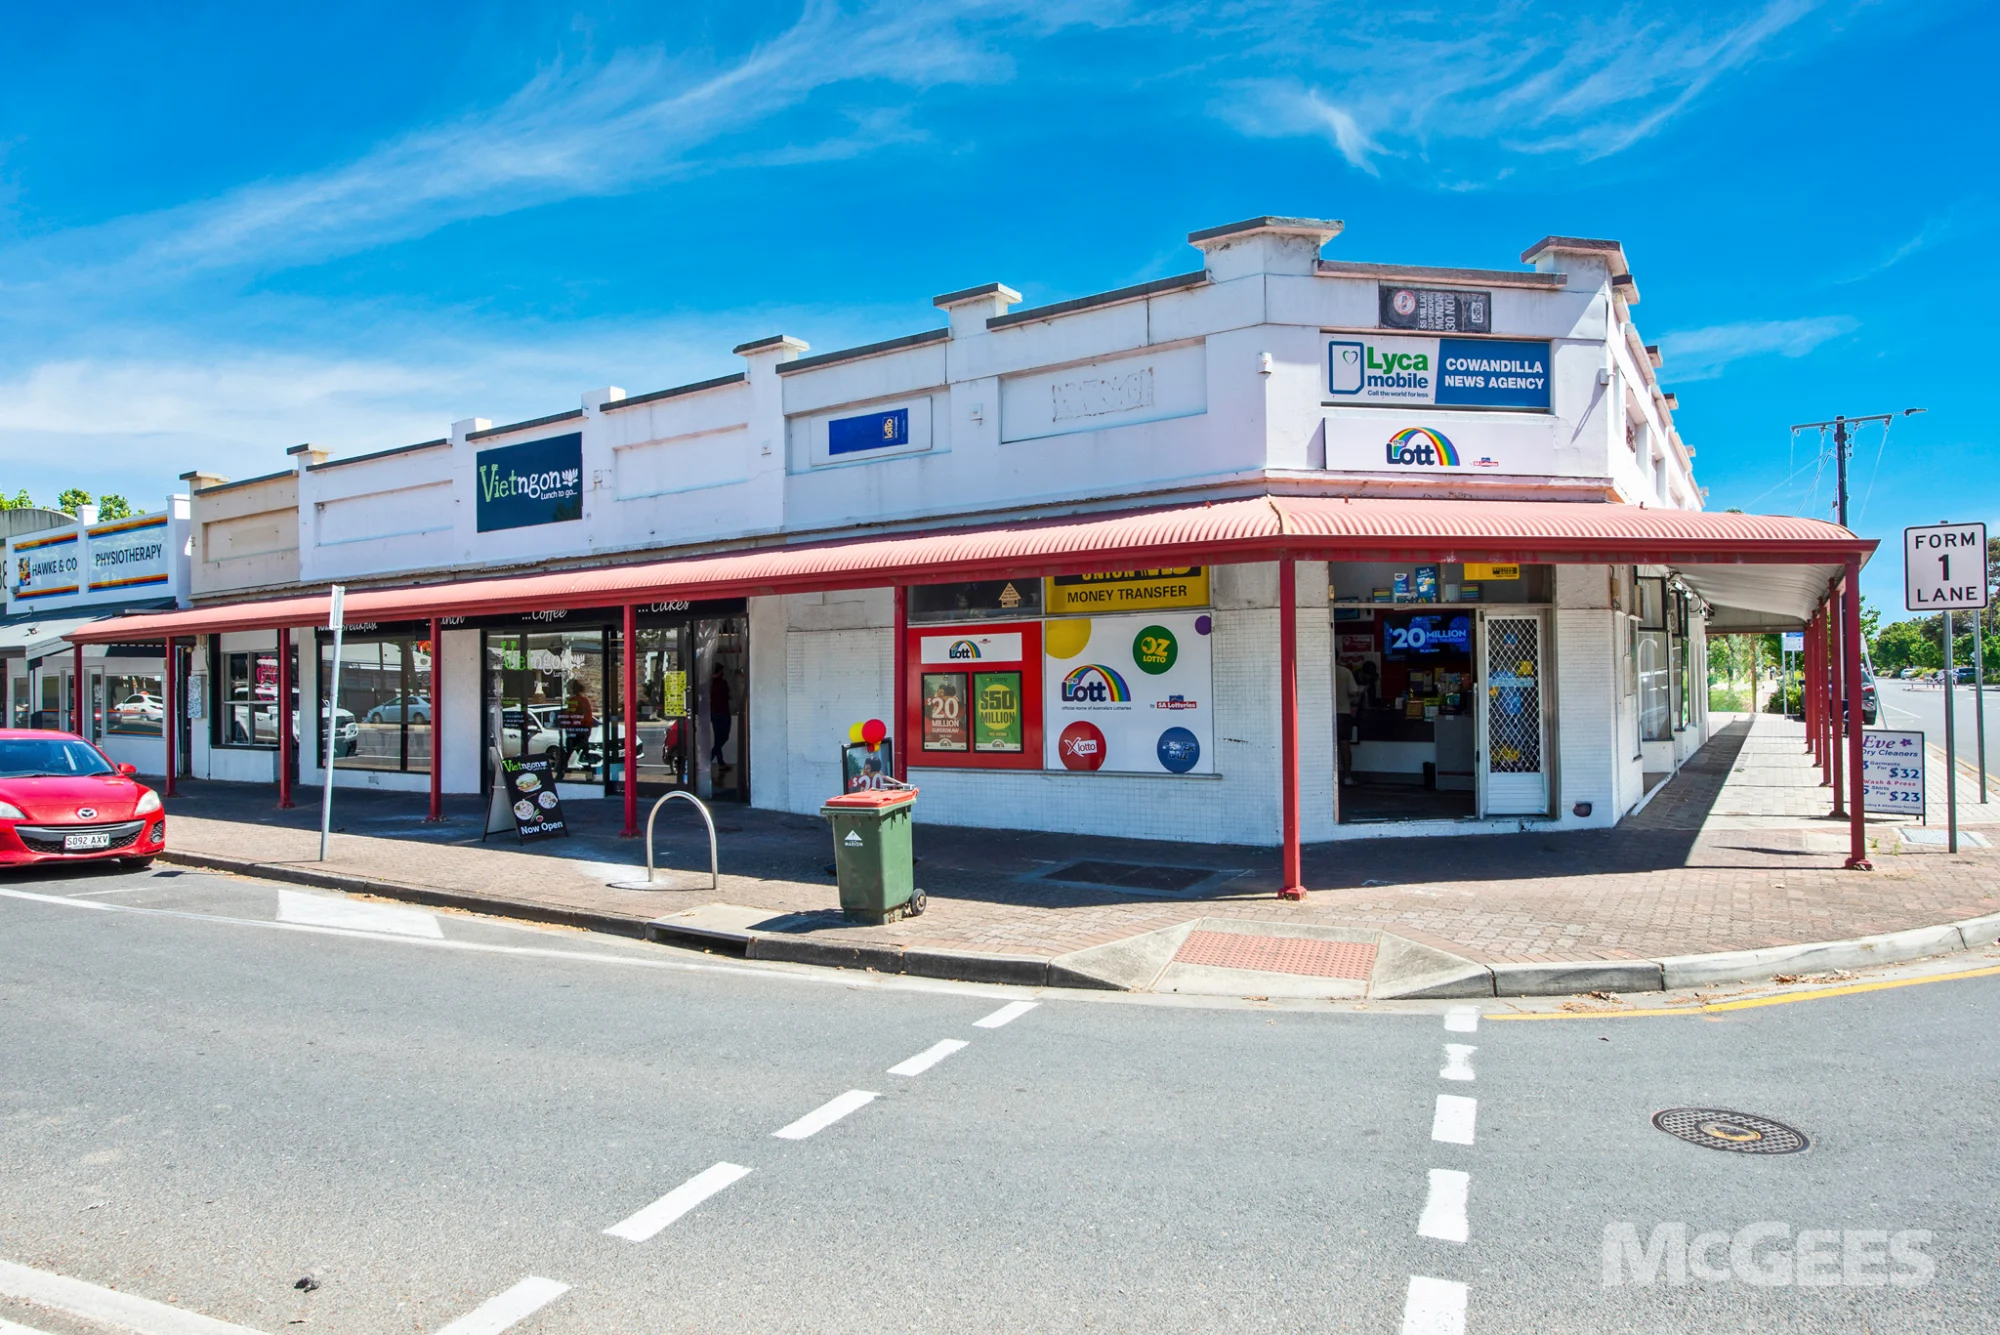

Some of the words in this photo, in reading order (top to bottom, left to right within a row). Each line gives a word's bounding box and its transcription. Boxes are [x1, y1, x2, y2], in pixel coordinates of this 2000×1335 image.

[1435, 293, 1444, 329] MONDAY
[1367, 346, 1428, 374] Lyca
[1445, 358, 1543, 373] COWANDILLA
[1367, 373, 1428, 388] mobile
[1445, 375, 1485, 387] NEWS
[1488, 376, 1544, 390] AGENCY
[1386, 443, 1434, 465] Lott
[479, 464, 561, 503] Vietngon
[540, 491, 557, 500] Lunch
[1915, 532, 1975, 549] FORM
[95, 544, 162, 567] PHYSIOTHERAPY
[32, 560, 57, 577] HAWKE
[58, 561, 65, 572] &
[66, 557, 78, 571] CO
[1938, 554, 1950, 581] 1
[1067, 590, 1115, 603] MONEY
[1118, 585, 1187, 600] TRANSFER
[1917, 586, 1977, 602] LANE
[1426, 629, 1466, 638] MILLION
[1141, 636, 1170, 657] OZ
[1143, 655, 1166, 663] LOTTO
[1061, 681, 1106, 702] Lott
[980, 690, 1014, 709] $50
[927, 697, 959, 719] $20
[931, 719, 960, 727] MILLION
[981, 711, 1015, 724] MILLION
[1862, 735, 1896, 749] Eve
[502, 760, 540, 773] Vietngon
[1889, 767, 1920, 779] $32
[1889, 791, 1920, 802] $23
[520, 825, 540, 834] Now
[540, 821, 563, 832] Open
[91, 835, 108, 844] AXV
